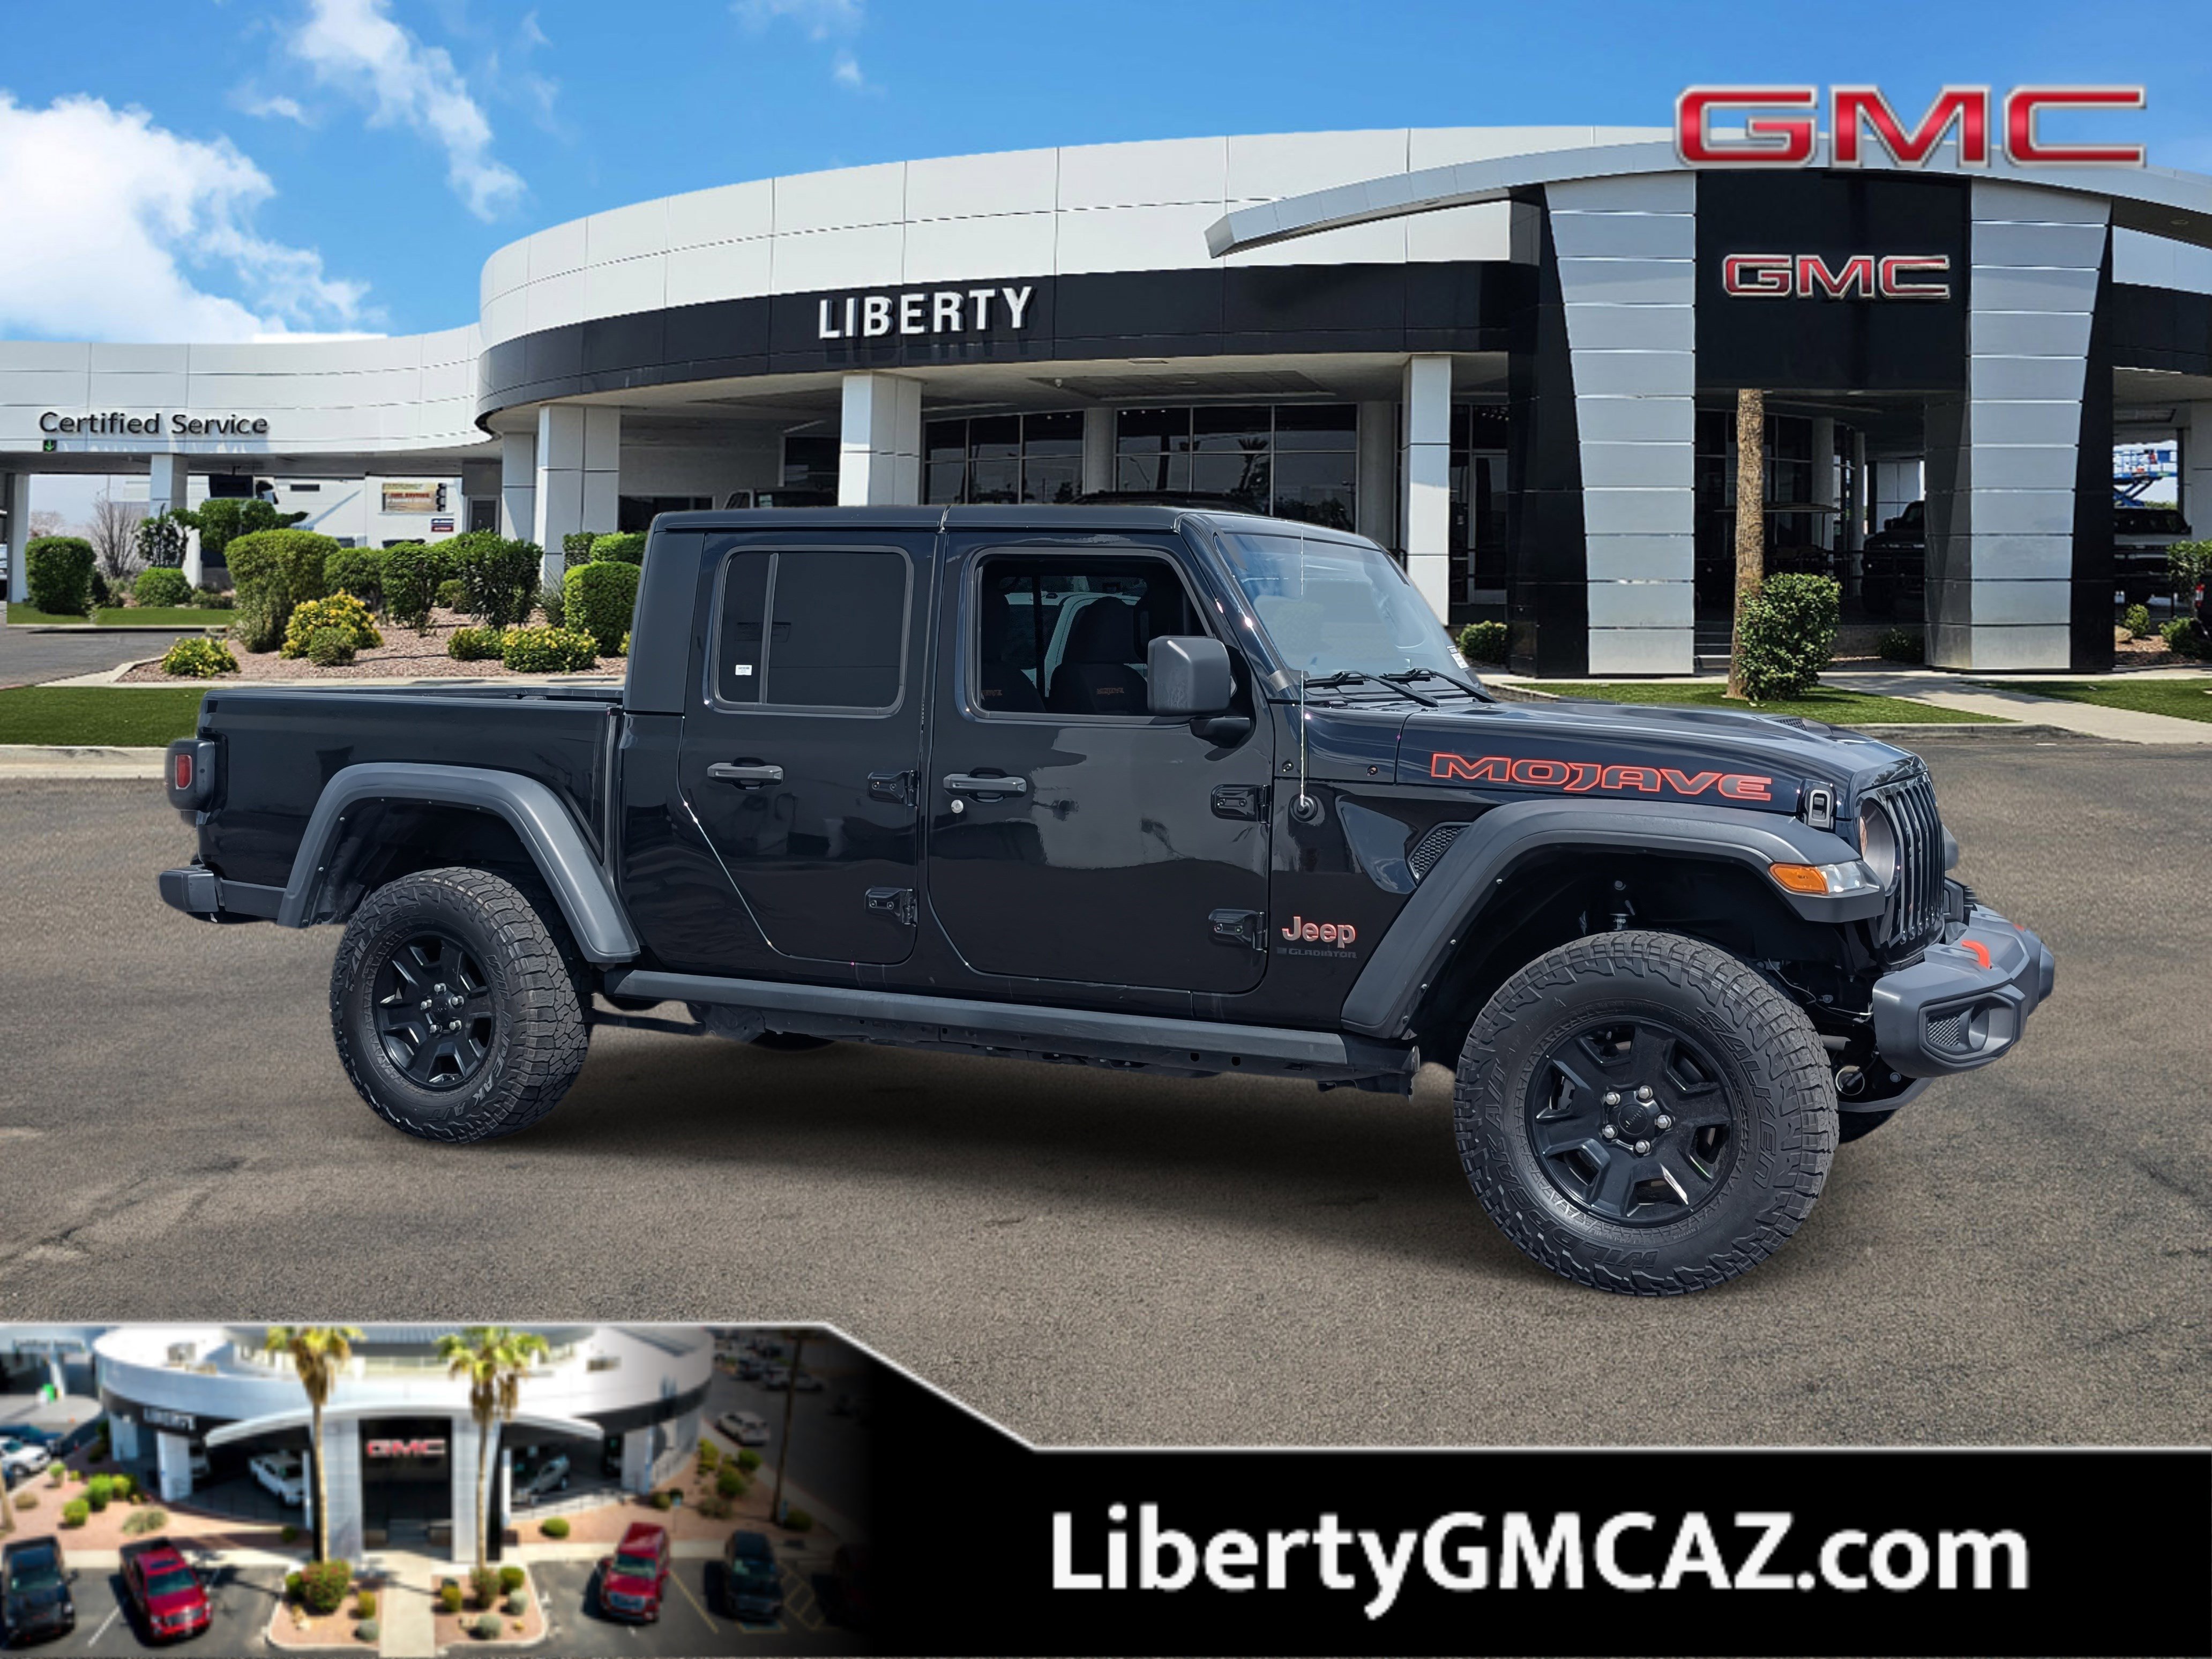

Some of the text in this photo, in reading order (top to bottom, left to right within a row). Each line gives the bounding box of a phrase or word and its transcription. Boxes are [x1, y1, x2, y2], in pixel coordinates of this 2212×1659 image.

[1722, 253, 1951, 300] GMC
[819, 286, 1033, 339] LIBERTY
[39, 412, 268, 435] Certified Service
[1431, 752, 1772, 801] MOJAVE
[1281, 916, 1356, 949] Jeep
[1289, 948, 1357, 959] GLADIATOR
[1697, 1007, 1776, 1189] FALKEN
[1488, 1133, 1659, 1268] WILDPEAK
